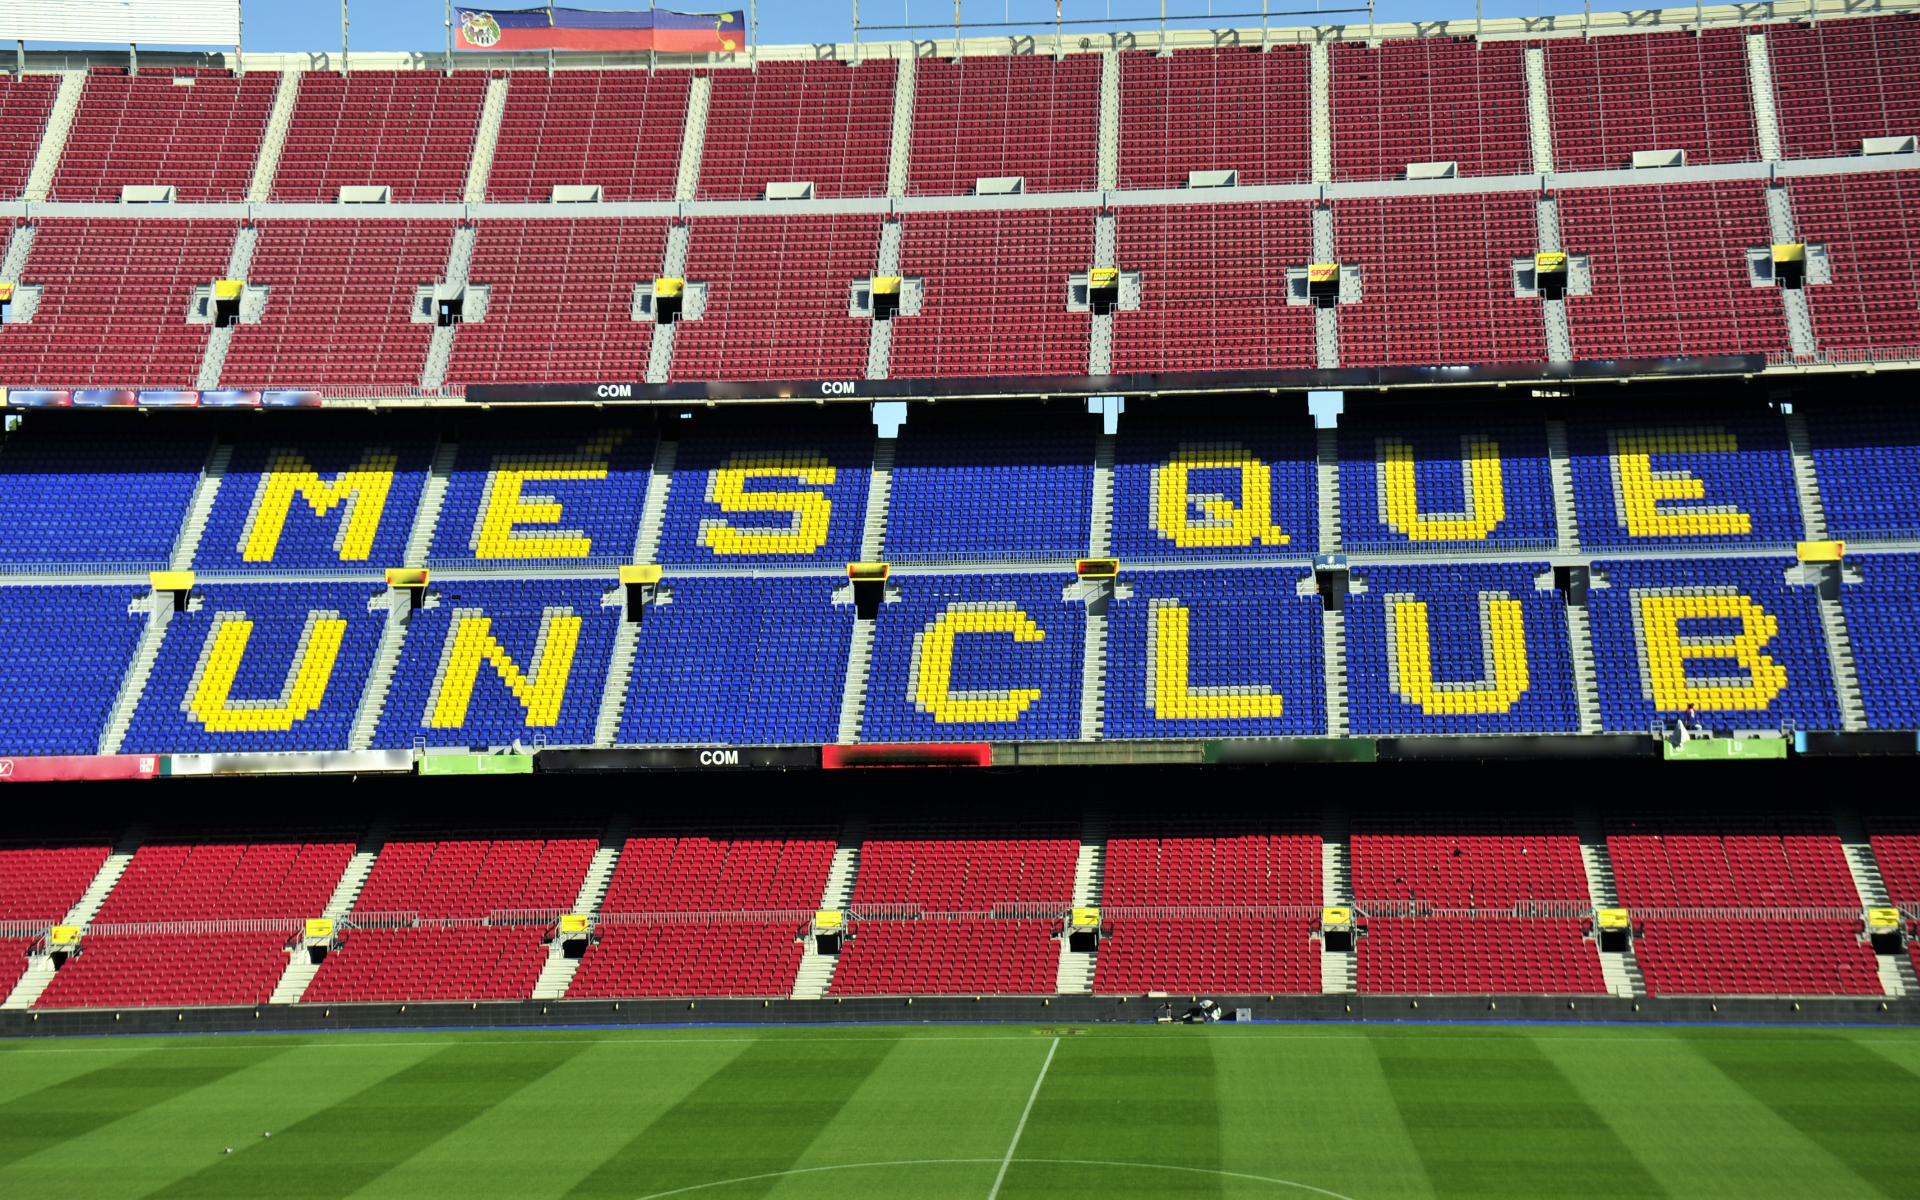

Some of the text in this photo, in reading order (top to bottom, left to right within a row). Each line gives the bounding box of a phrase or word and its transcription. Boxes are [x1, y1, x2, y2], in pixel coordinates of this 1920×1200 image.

[597, 385, 632, 397] COM
[821, 382, 855, 394] COM
[1154, 434, 1752, 548] QUE
[187, 594, 1789, 733] UN CLUB
[700, 750, 739, 765] COM
